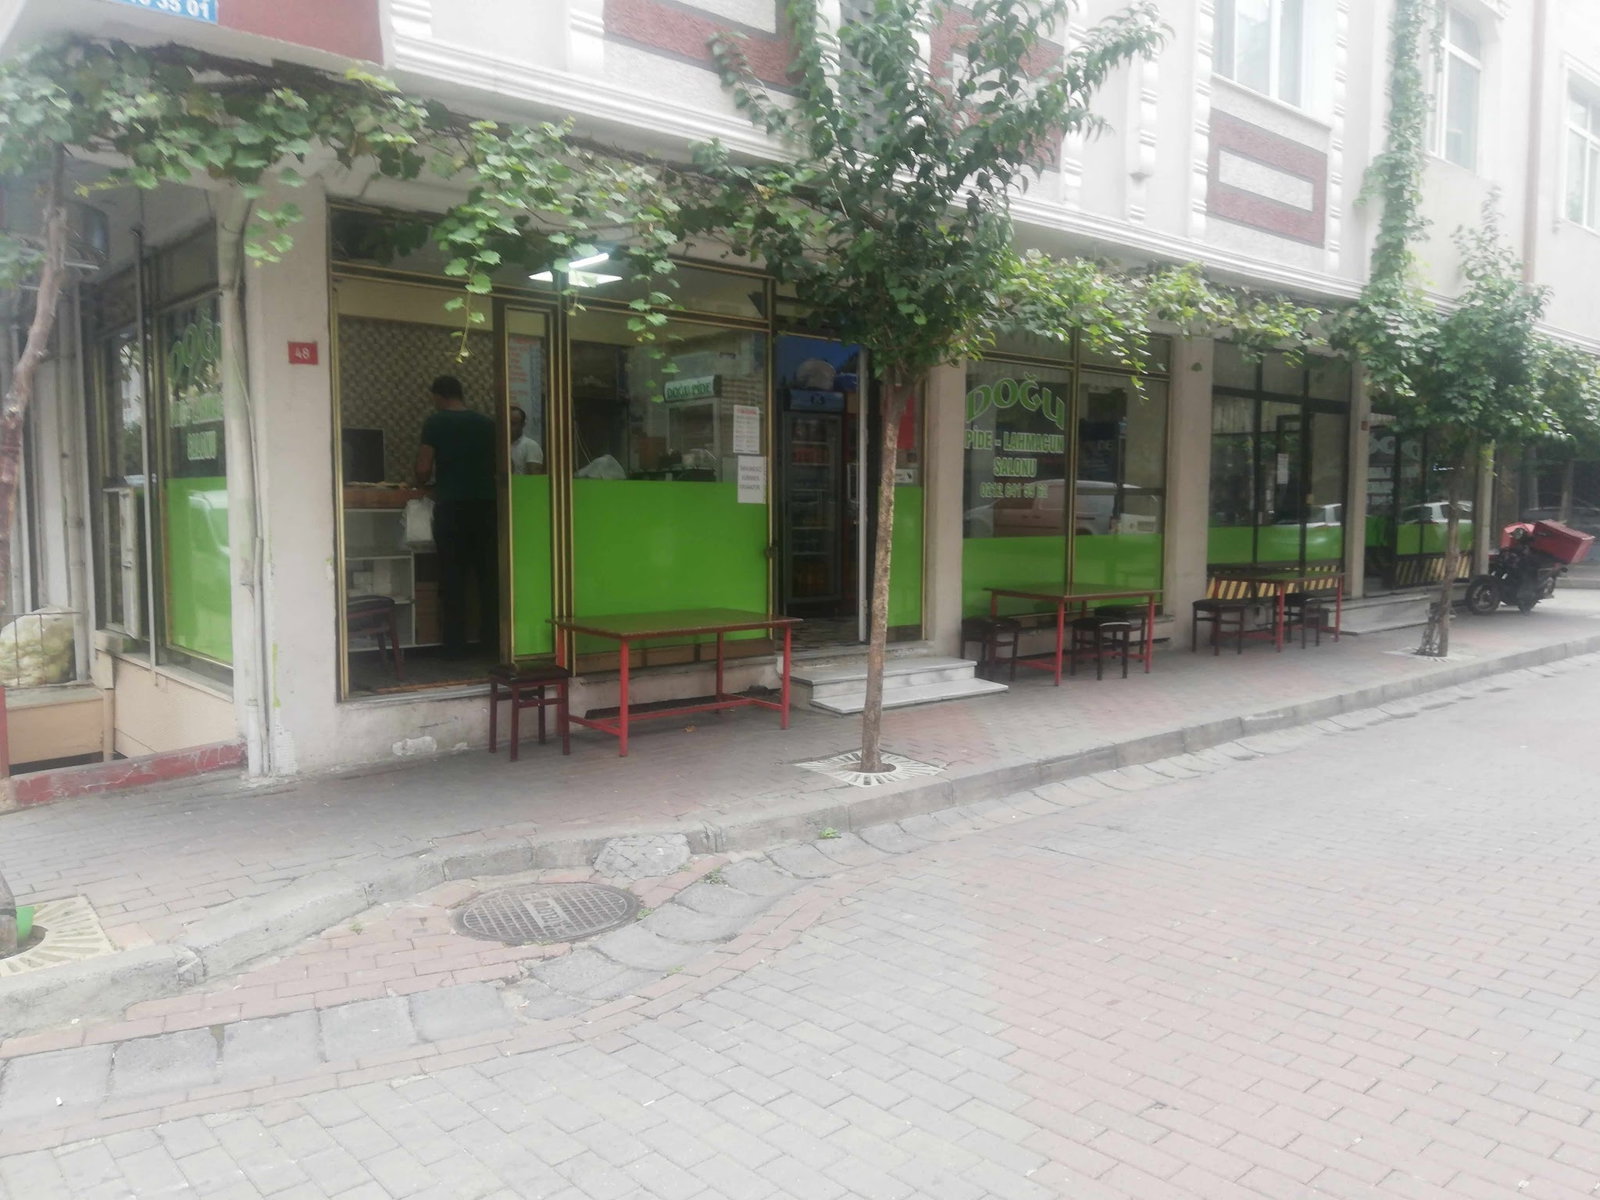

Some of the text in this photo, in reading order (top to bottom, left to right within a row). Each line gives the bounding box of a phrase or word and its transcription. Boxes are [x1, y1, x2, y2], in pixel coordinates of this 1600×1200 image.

[295, 347, 310, 360] 48
[966, 371, 1065, 430] DOĞU
[964, 425, 993, 450] PİDE
[993, 456, 1038, 478] SALONU
